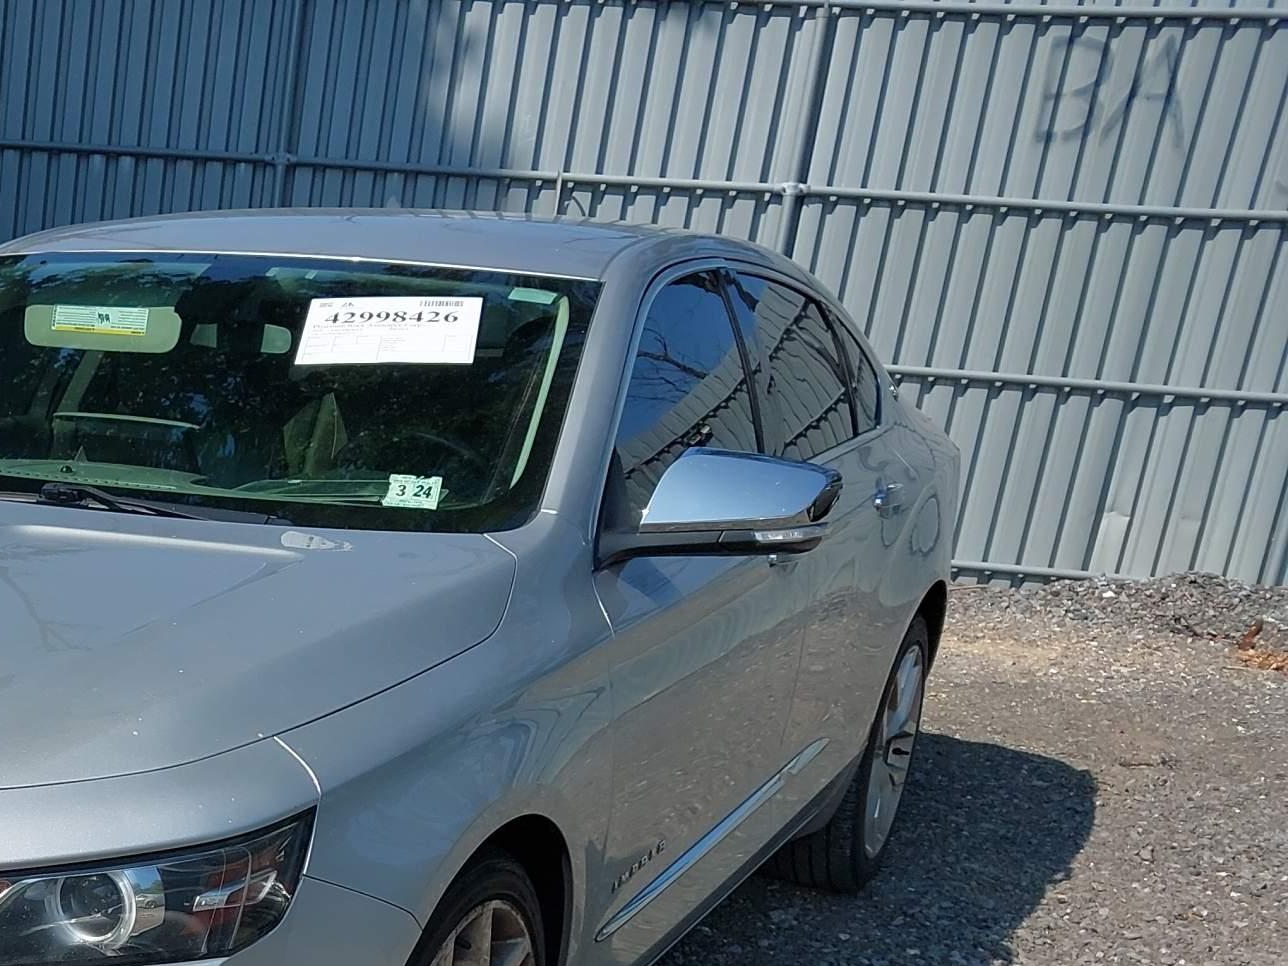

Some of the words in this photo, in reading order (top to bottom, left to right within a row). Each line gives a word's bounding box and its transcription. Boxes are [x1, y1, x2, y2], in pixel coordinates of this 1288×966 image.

[325, 311, 459, 324] 42998426
[396, 485, 406, 496] 3
[413, 485, 433, 498] 24
